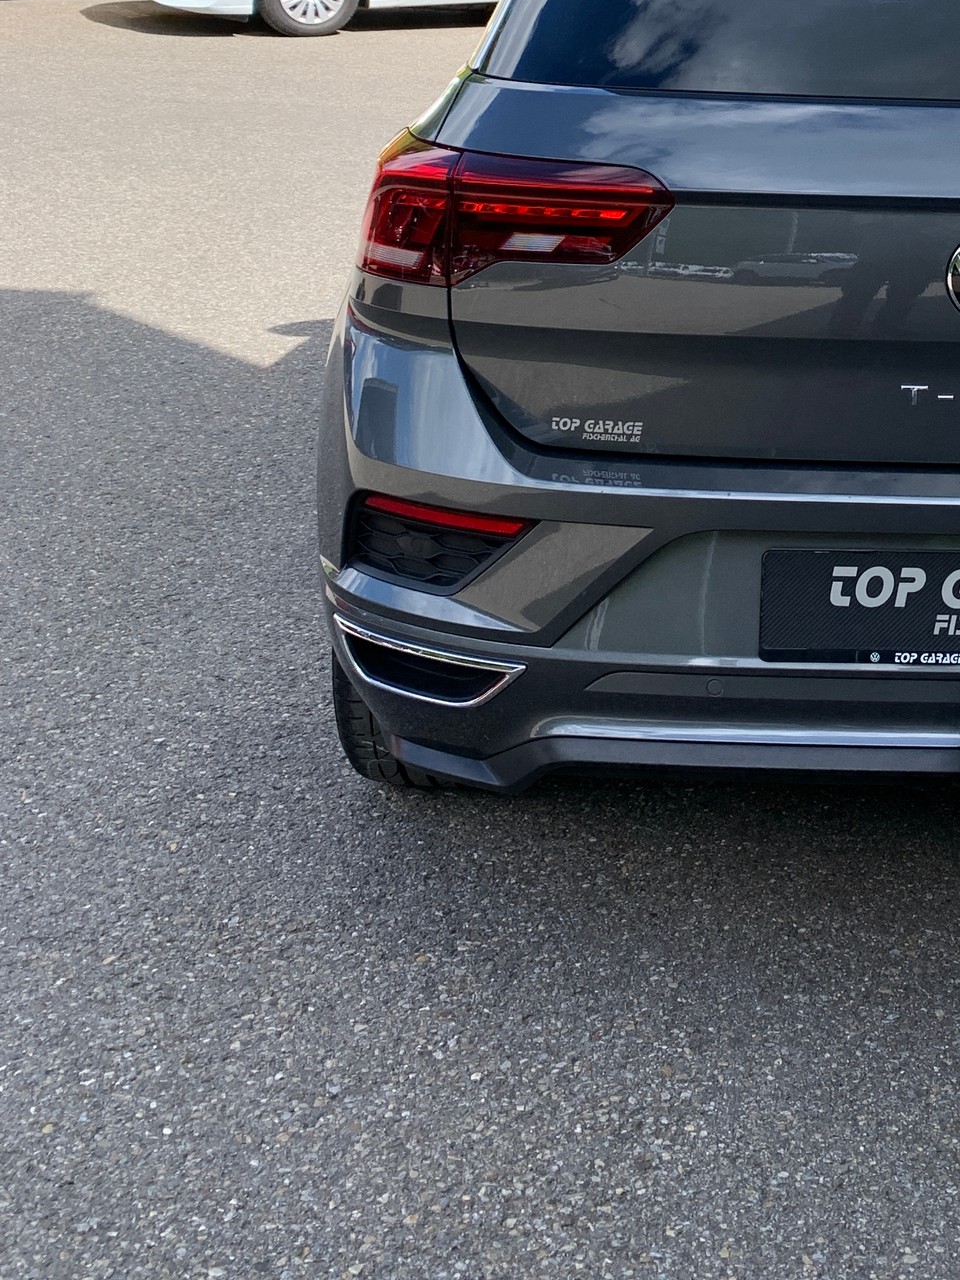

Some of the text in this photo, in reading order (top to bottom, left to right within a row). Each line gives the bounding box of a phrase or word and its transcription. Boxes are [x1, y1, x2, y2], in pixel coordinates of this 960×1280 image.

[551, 417, 644, 435] TOP GARAGE
[582, 432, 641, 443] FISCHENTHAL AG
[829, 565, 927, 608] TOP
[894, 652, 917, 664] TOP
